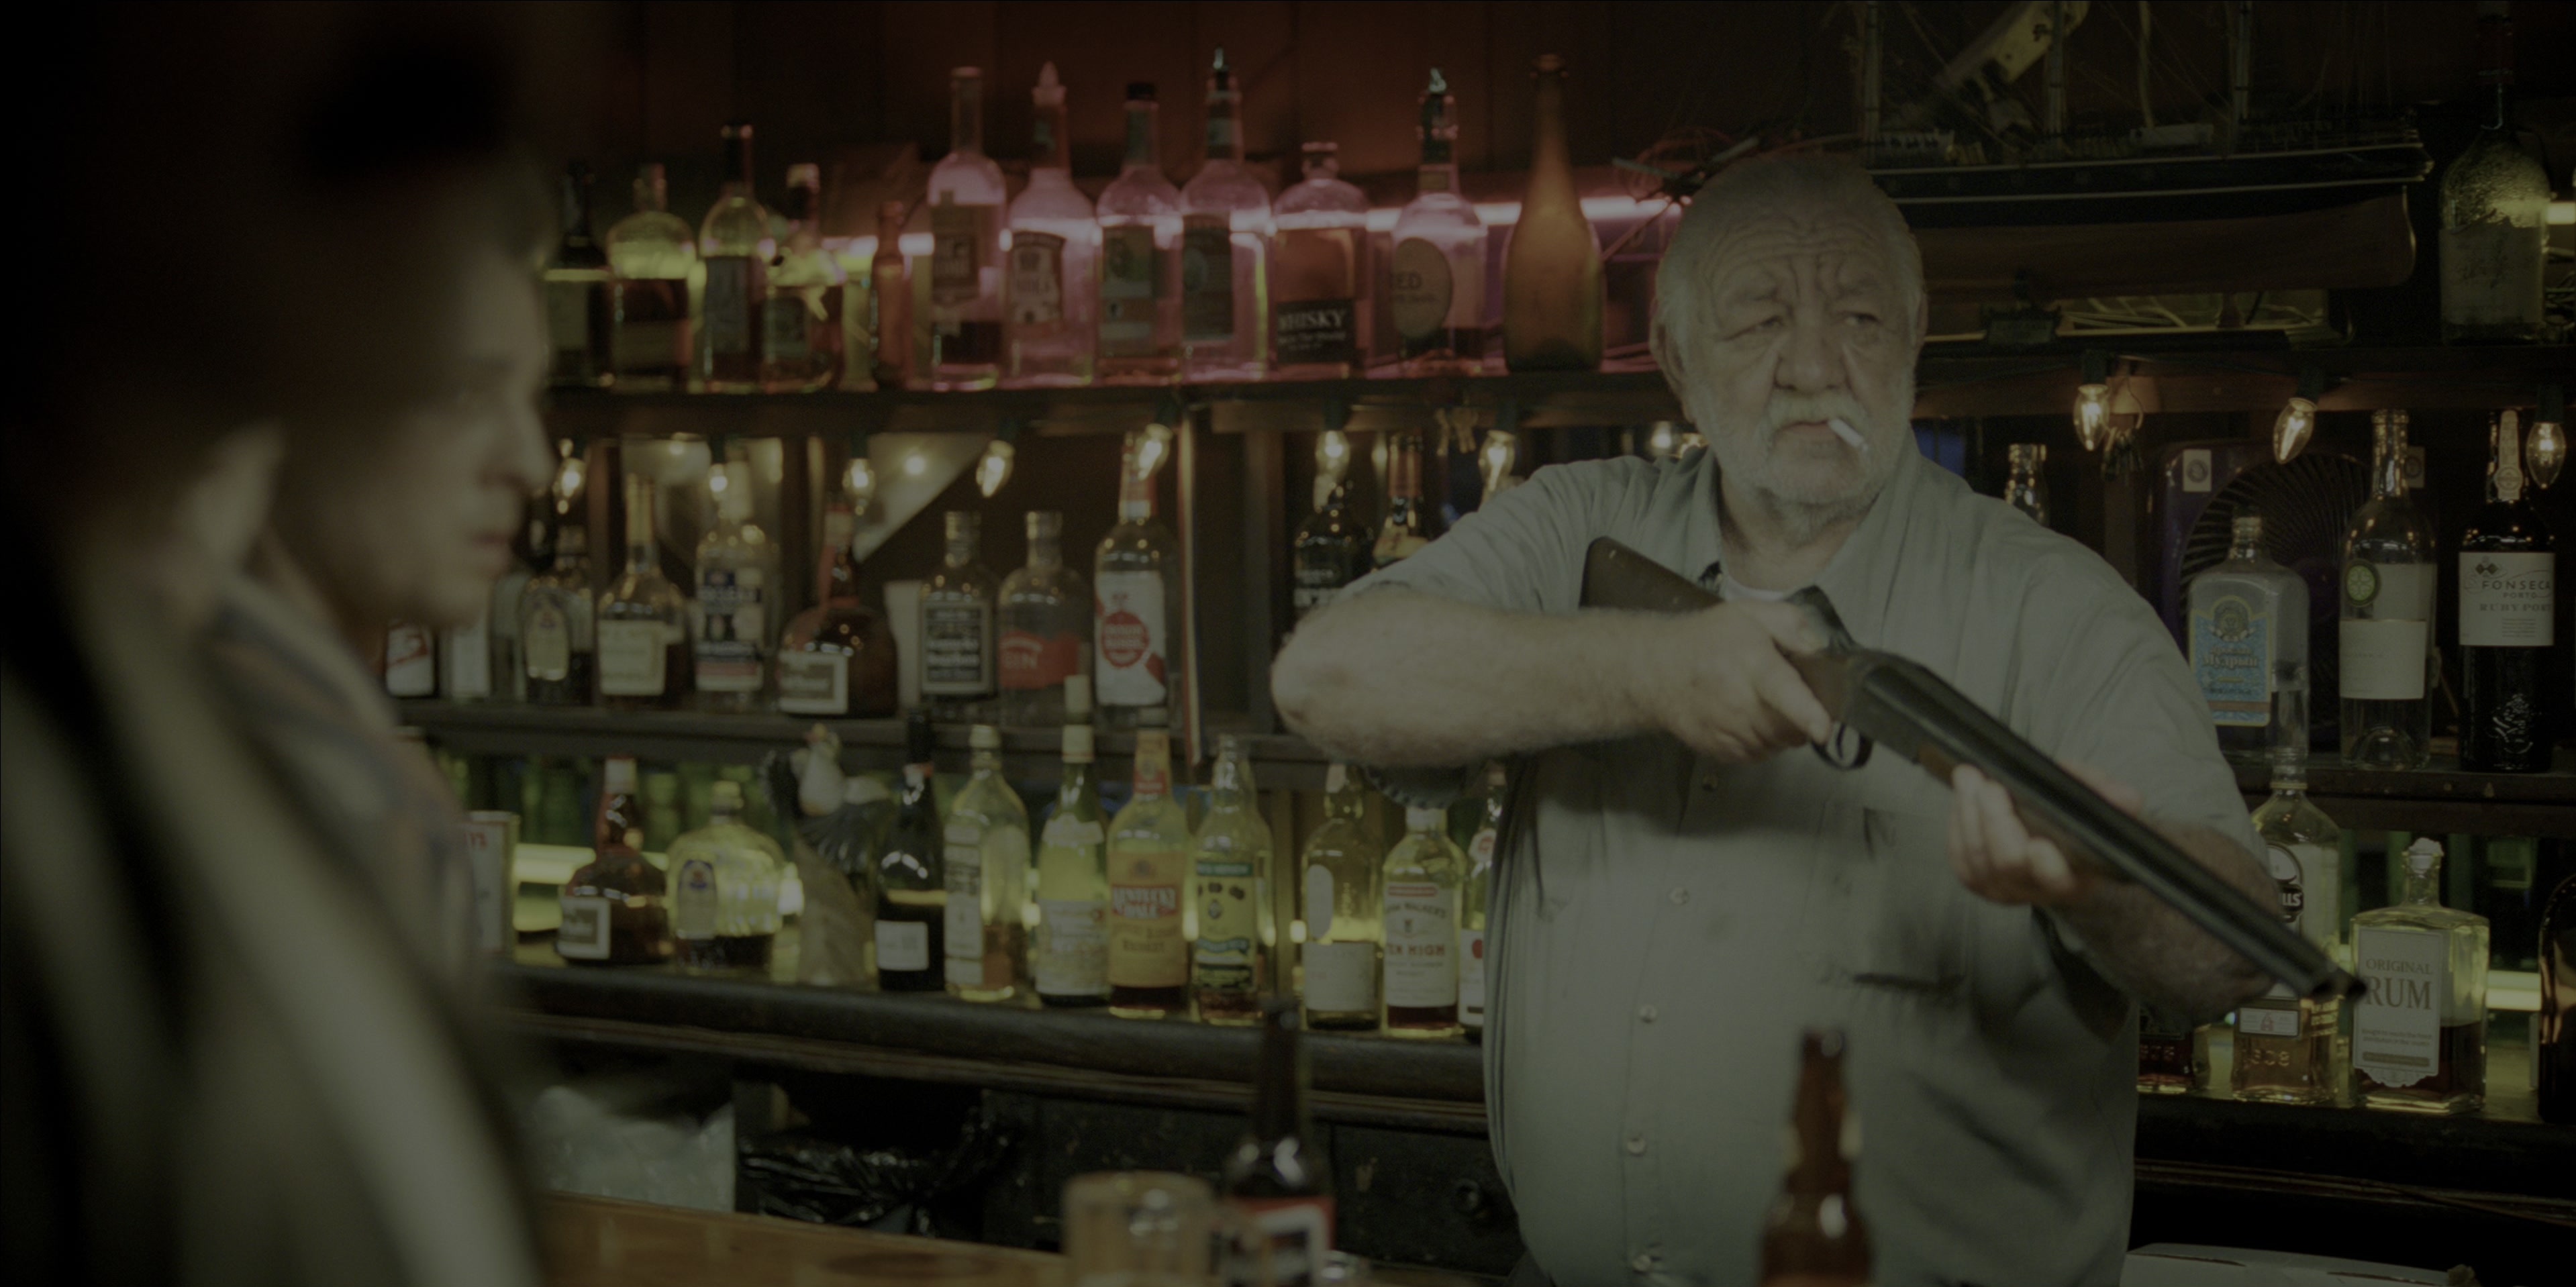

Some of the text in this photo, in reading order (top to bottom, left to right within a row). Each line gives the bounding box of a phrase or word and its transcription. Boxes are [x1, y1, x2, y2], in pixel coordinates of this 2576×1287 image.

[2481, 580, 2551, 590] FONSECA
[2479, 603, 2518, 612] RUBY
[1408, 943, 1445, 957] HIGH
[2365, 958, 2434, 975] ORIGINAL
[2364, 976, 2432, 1011] RUM
